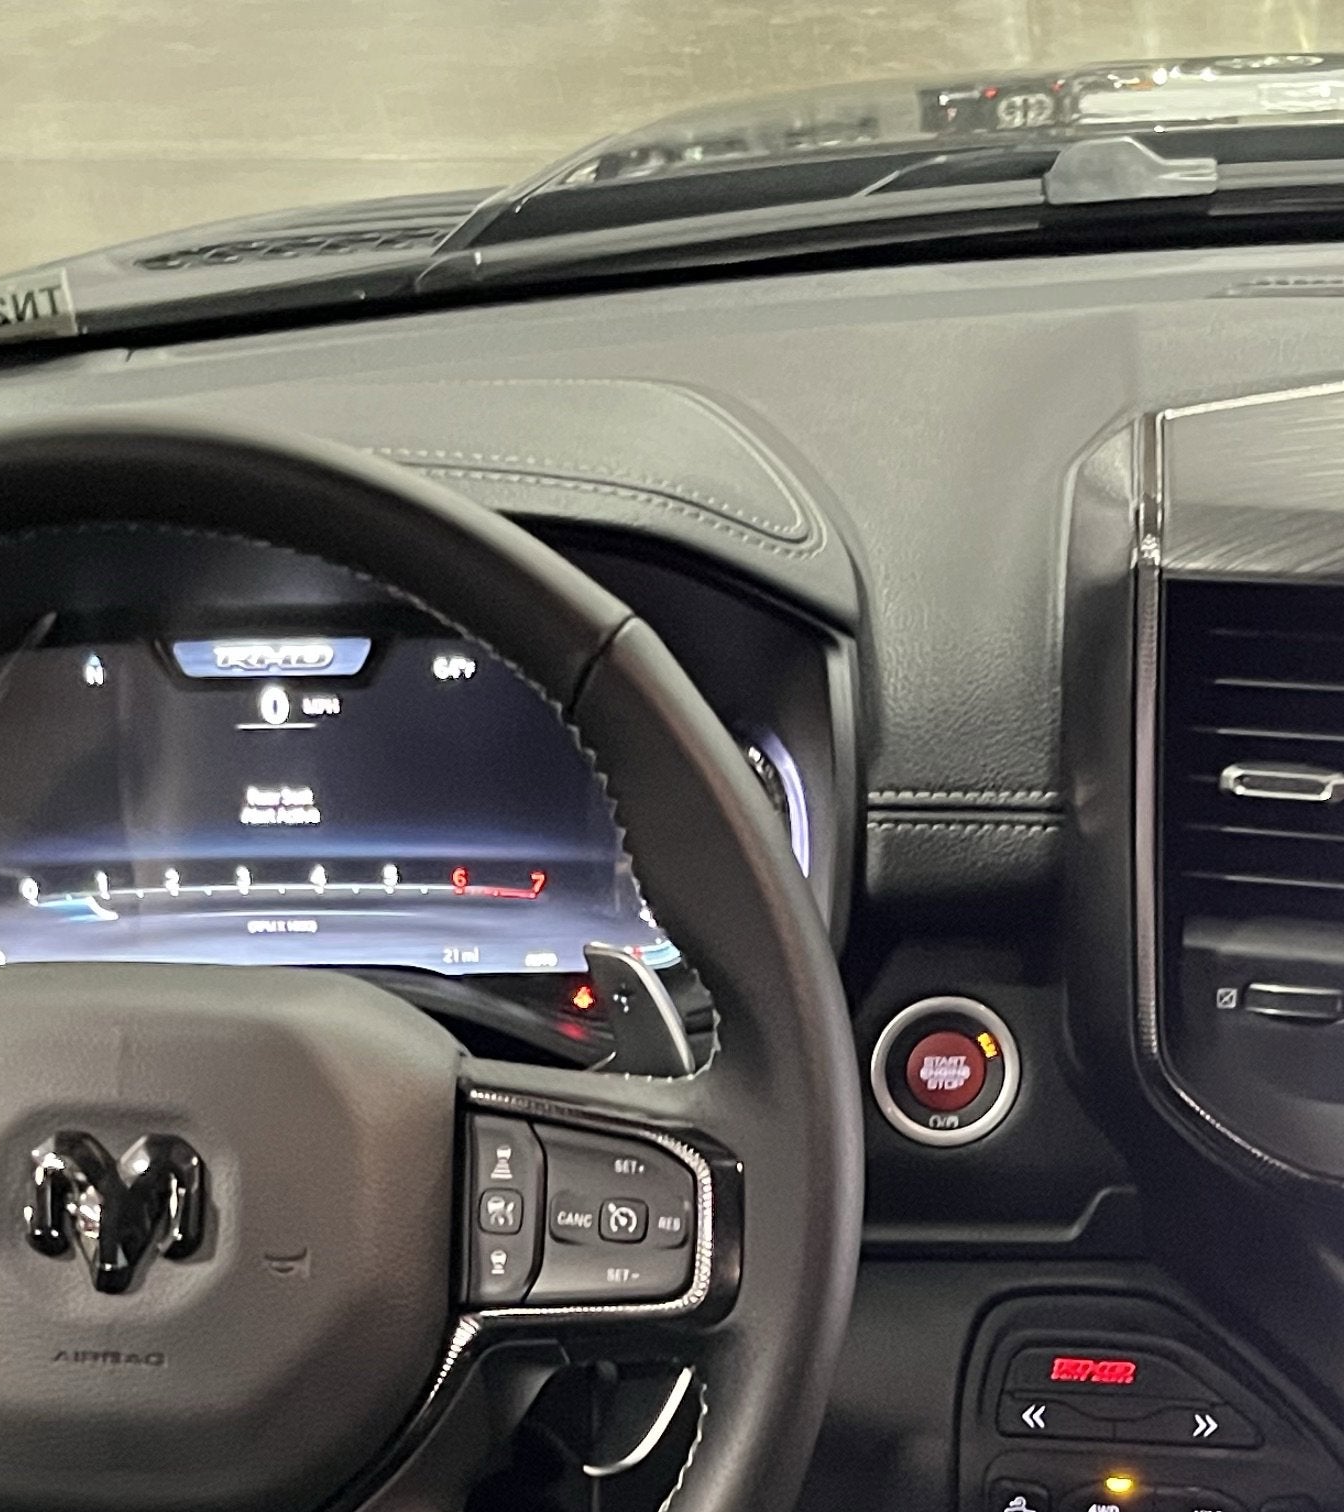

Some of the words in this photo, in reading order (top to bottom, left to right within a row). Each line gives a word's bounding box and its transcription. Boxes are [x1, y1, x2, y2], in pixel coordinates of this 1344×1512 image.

[260, 686, 291, 725] 0
[451, 865, 470, 888] 6
[529, 870, 547, 893] 7
[923, 1055, 967, 1067] START
[52, 1350, 167, 1368] AIRBAG
